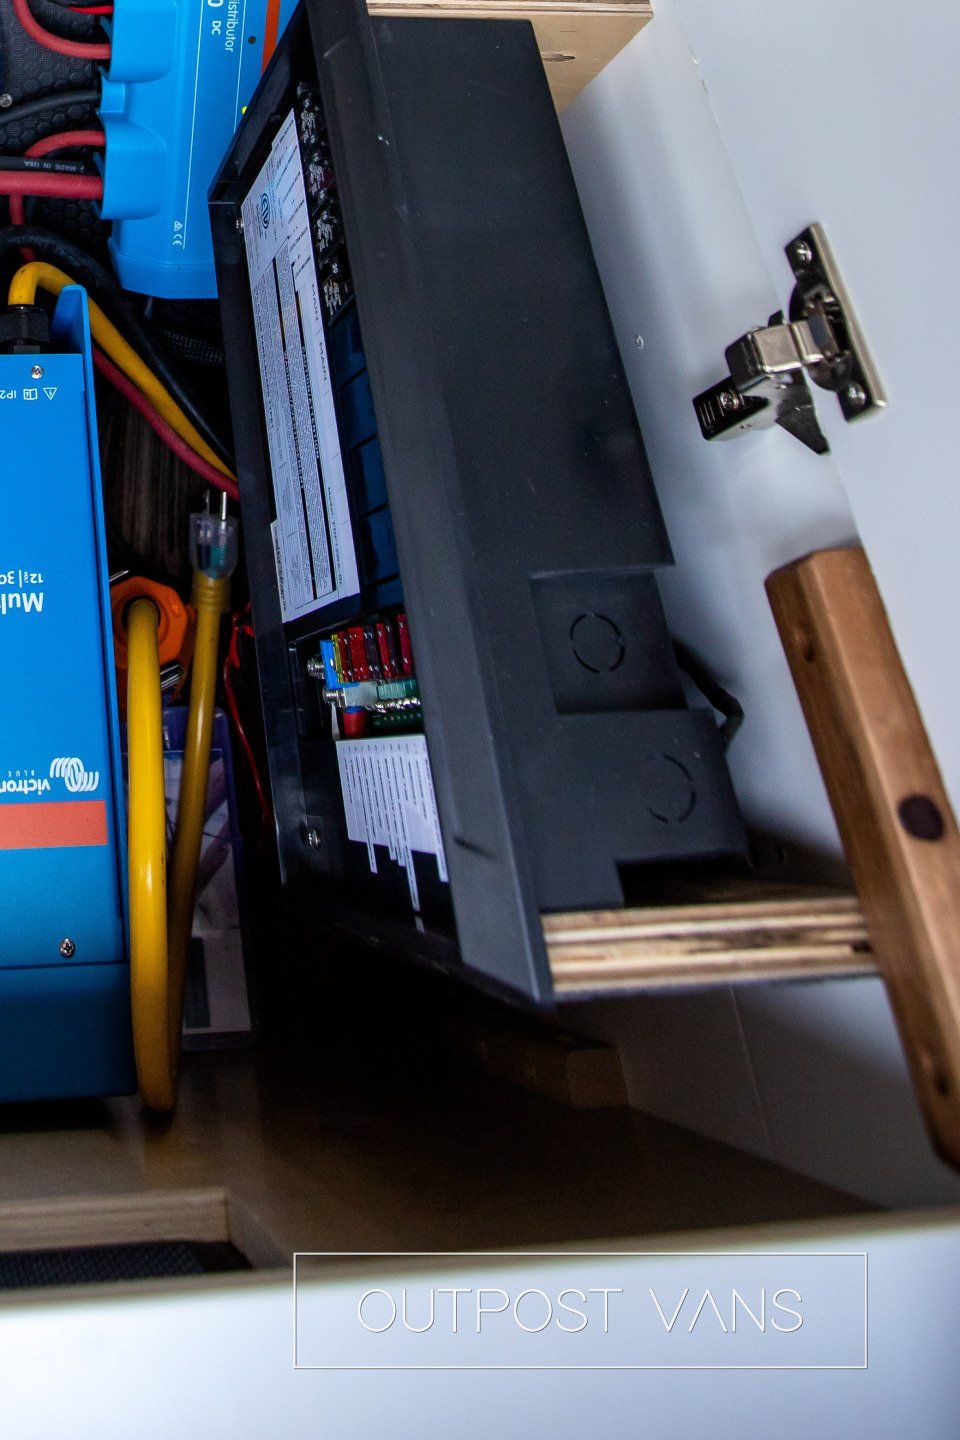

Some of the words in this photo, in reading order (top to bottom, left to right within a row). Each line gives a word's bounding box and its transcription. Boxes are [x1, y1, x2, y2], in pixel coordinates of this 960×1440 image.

[211, 20, 222, 35] DC
[310, 282, 319, 322] MAIN
[318, 339, 328, 383] MAIN
[8, 769, 35, 777] BLUE
